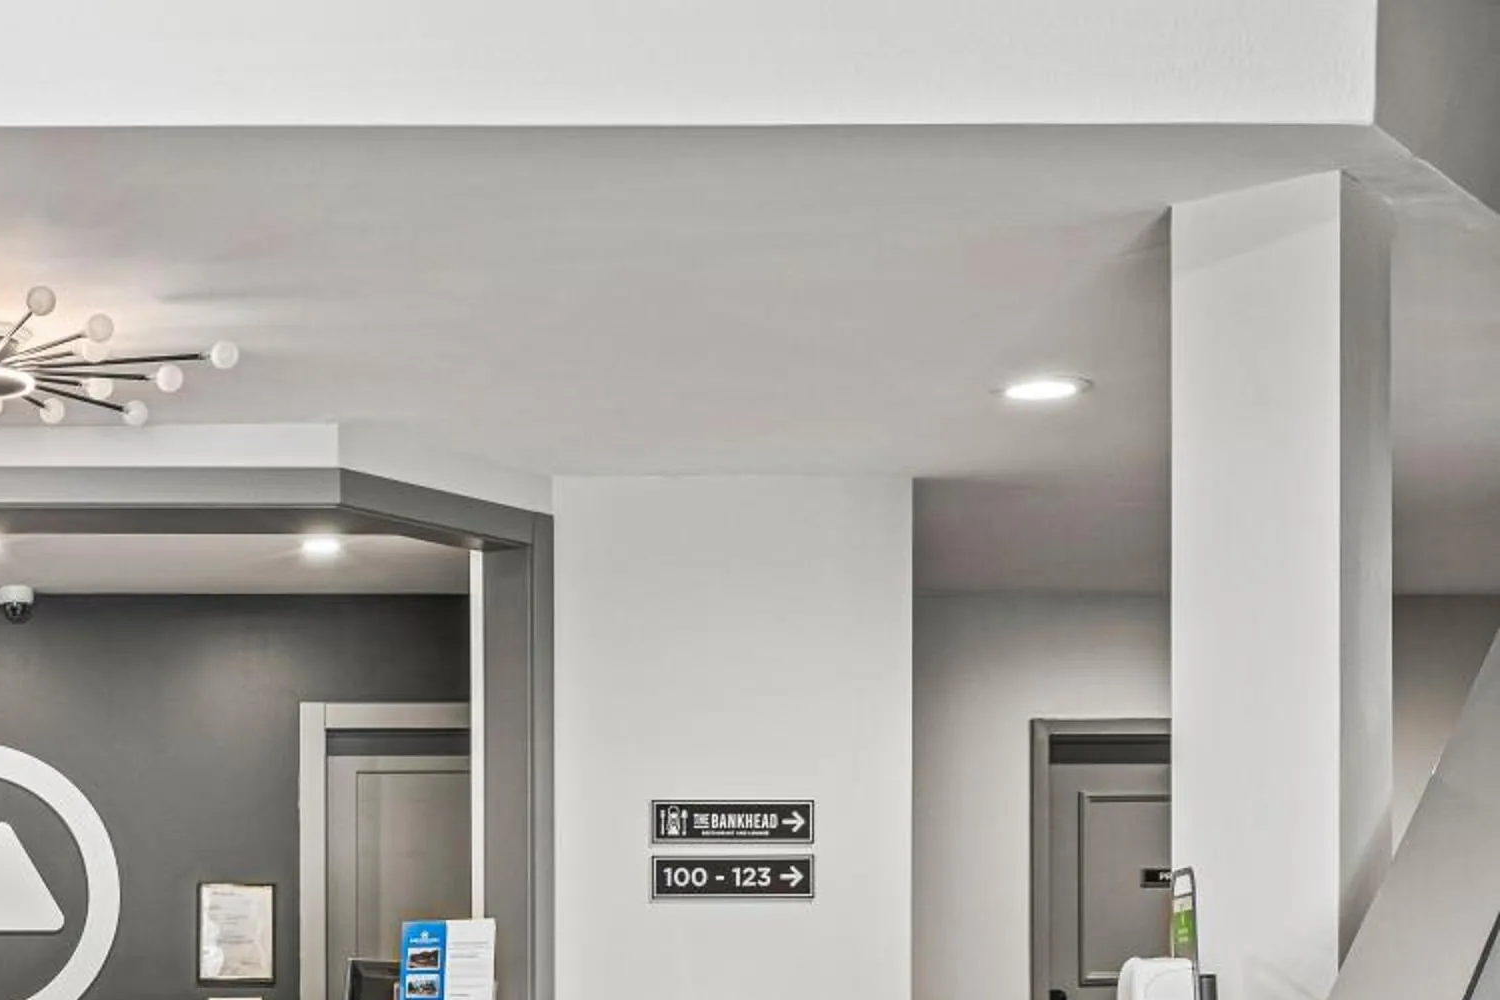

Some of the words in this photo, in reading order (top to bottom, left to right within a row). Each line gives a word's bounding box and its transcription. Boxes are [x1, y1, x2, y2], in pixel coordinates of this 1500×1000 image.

[711, 813, 778, 829] BANKHEAD
[663, 867, 708, 887] 100
[732, 867, 772, 887] 123
